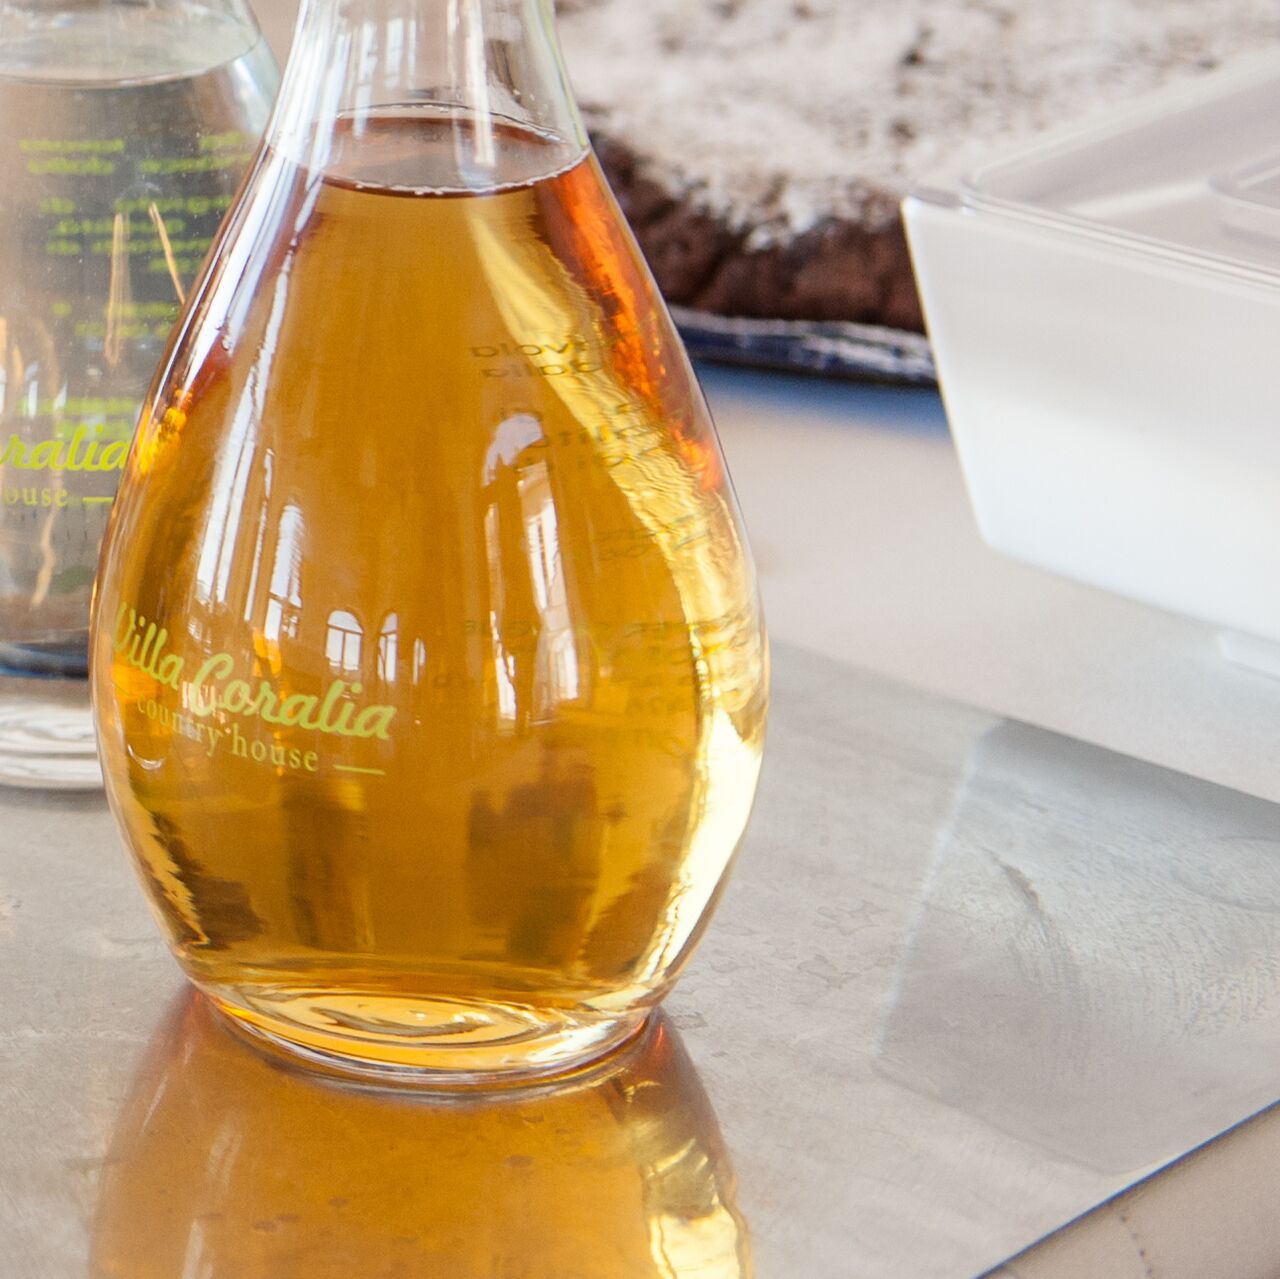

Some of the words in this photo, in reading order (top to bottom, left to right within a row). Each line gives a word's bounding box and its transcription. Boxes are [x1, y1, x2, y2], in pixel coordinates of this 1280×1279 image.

[112, 601, 184, 696] Villa
[190, 653, 397, 740] Coralia
[137, 695, 223, 757] country
[233, 723, 319, 771] house
